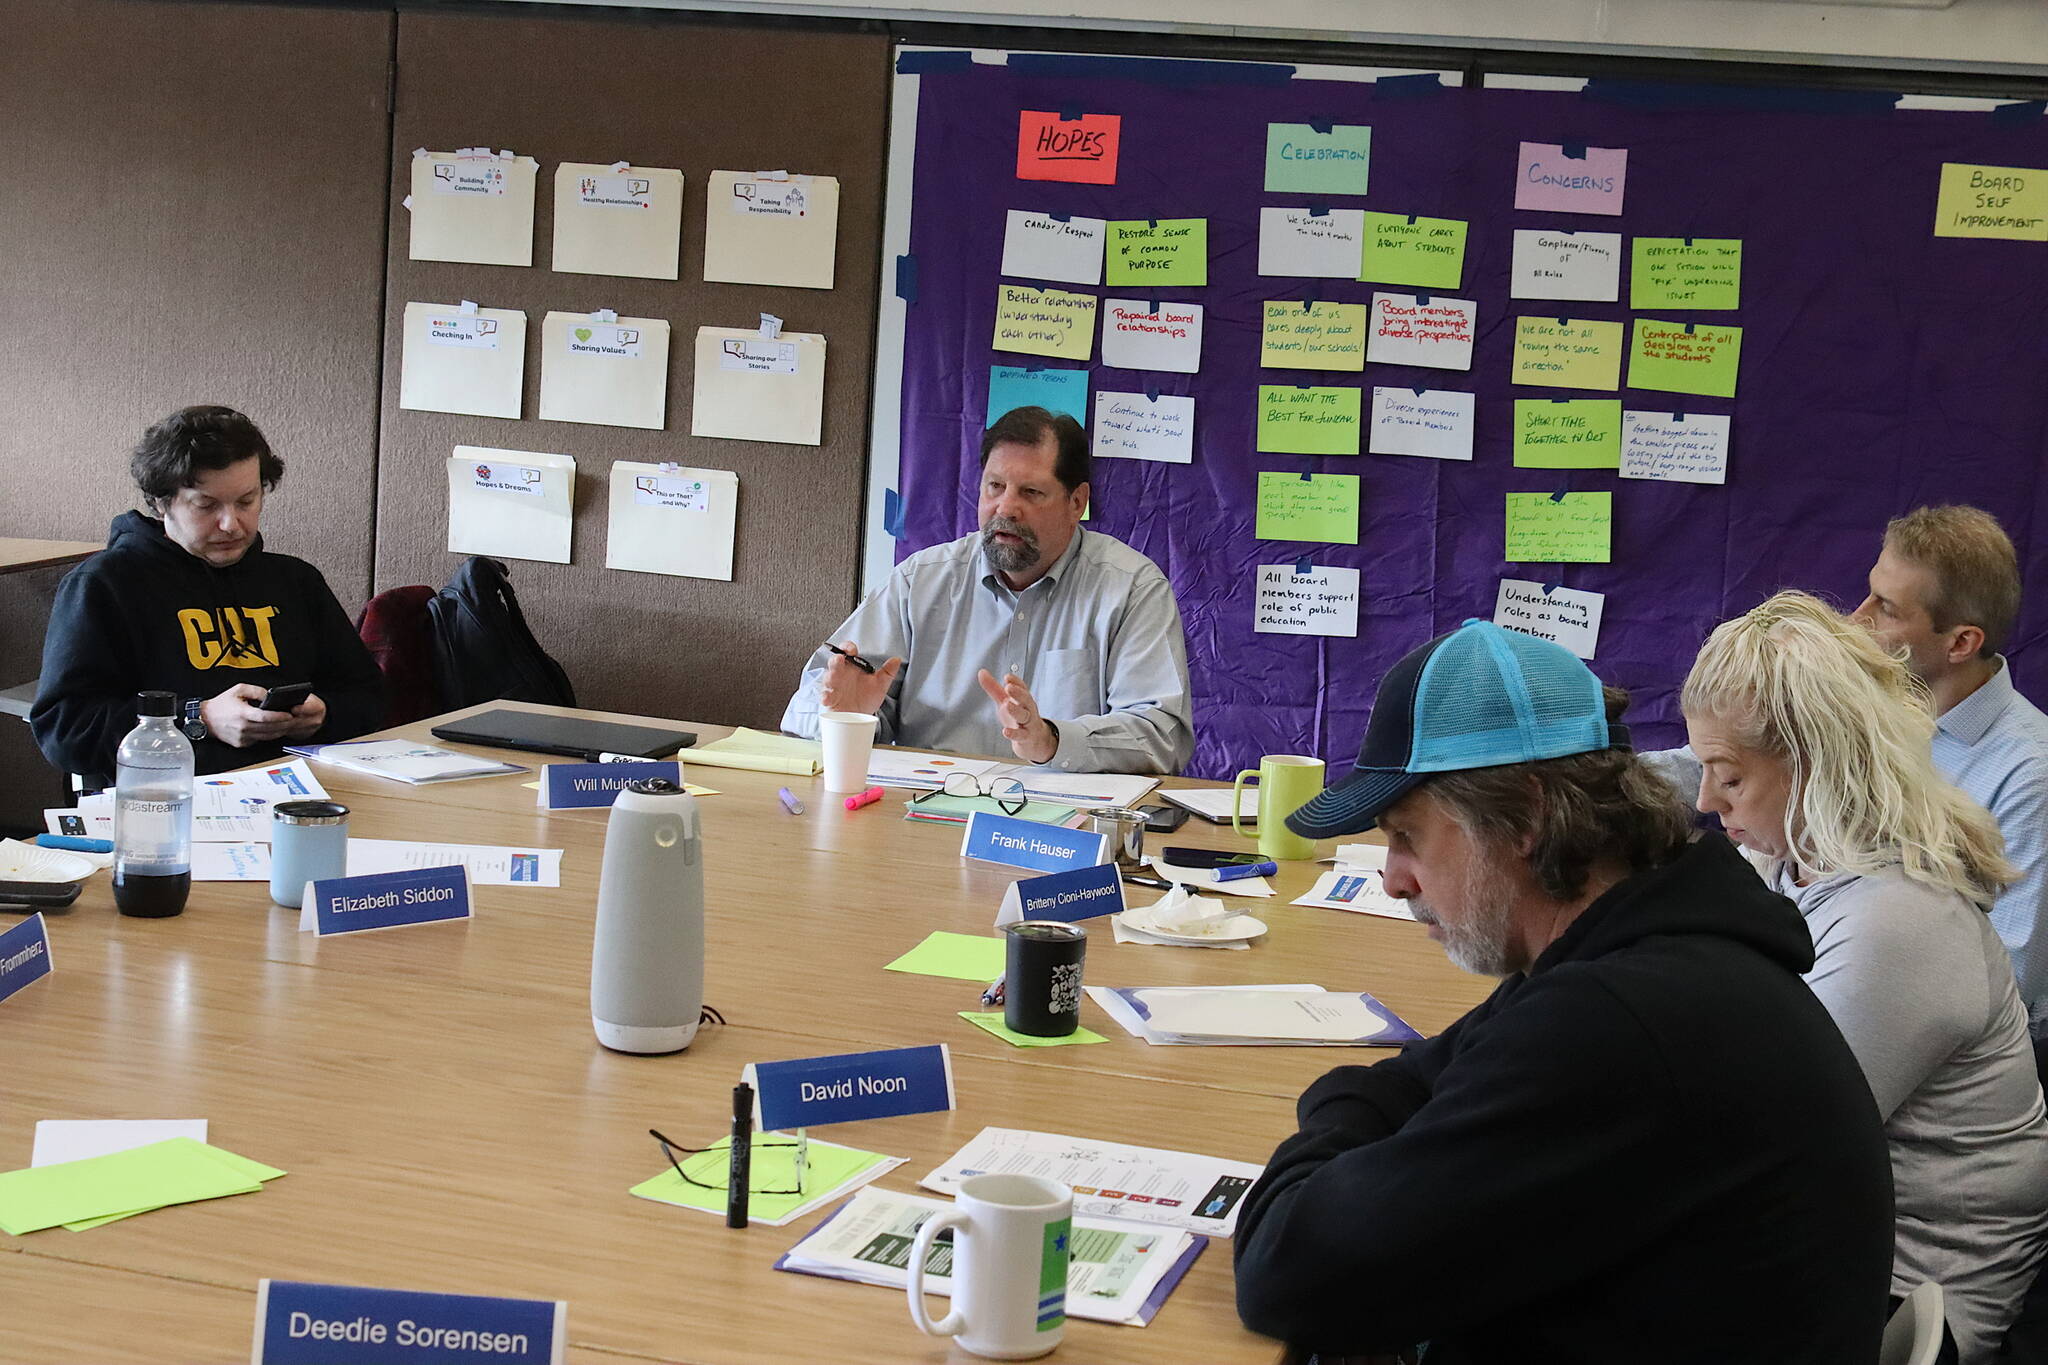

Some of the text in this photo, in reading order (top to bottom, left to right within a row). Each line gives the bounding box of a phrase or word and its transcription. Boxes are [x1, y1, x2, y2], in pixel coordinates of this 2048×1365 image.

[1036, 126, 1107, 157] HOPES
[1281, 142, 1367, 160] CELEBRATION
[459, 176, 485, 186] Building
[1528, 163, 1614, 193] CONCERNS
[1970, 170, 2025, 192] BOARD
[454, 184, 489, 194] Community
[760, 198, 781, 207] Taking
[1975, 193, 2012, 208] SELF
[748, 206, 791, 216] Responsibility
[1287, 215, 1298, 224] We
[1953, 212, 2045, 228] IMPROVEMENT
[1118, 228, 1191, 239] RESTORE SENSE
[1311, 230, 1324, 238] last
[1429, 228, 1455, 238] CARES
[1377, 238, 1456, 256] ABOUT STUDENTS
[1128, 260, 1173, 270] PURPOSE
[1006, 289, 1096, 309] Better relationships
[1112, 307, 1194, 324] Repaired board
[1267, 307, 1341, 320] each one of us
[1377, 299, 1465, 318] Board members
[1117, 322, 1187, 338] relationships
[1266, 323, 1352, 339] cares deeply about
[1383, 316, 1410, 332] bring
[1522, 323, 1594, 339] We are not all
[431, 330, 473, 343] Checking In
[1001, 328, 1024, 339] each
[1378, 327, 1471, 344] diverse perspectives
[1701, 332, 1714, 343] of
[1716, 334, 1732, 346] all
[572, 343, 626, 356] Sharing Values
[1554, 342, 1569, 353] the
[1573, 344, 1600, 355] same
[1643, 339, 1716, 354] decisions are
[742, 354, 762, 364] Sharing
[1642, 351, 1712, 364] the students
[748, 362, 771, 371] Stories
[1041, 374, 1068, 384] TERMS
[1267, 392, 1338, 405] ALL WANT THE
[1109, 402, 1181, 421] Continue to work
[1385, 398, 1460, 418] Diverse experiences
[1267, 410, 1294, 422] BEST
[1299, 411, 1314, 423] FOR
[1526, 411, 1586, 429] SHORT TIME
[1102, 419, 1132, 431] toward
[1164, 429, 1183, 437] good
[1101, 435, 1114, 444] for
[1524, 431, 1568, 445] TOGETHER
[475, 480, 498, 490] Hopes
[505, 483, 532, 492] Dreams
[674, 500, 690, 509] Why?
[1264, 571, 1328, 587] All board
[1262, 588, 1354, 603] members support
[1505, 587, 1588, 616] Understanding
[1261, 603, 1338, 617] role of public
[1504, 605, 1589, 629] roles as board
[1260, 615, 1307, 628] education
[177, 606, 276, 670] CAT
[1502, 623, 1557, 641] members
[573, 778, 598, 792] Will
[991, 832, 1077, 860] Frank Hauser
[331, 885, 454, 915] Elizabeth Siddon
[1026, 883, 1116, 912] Britteny Cioni-Haywood
[800, 1072, 907, 1103] David Noon
[288, 1311, 529, 1354] Deedie Sorensen
